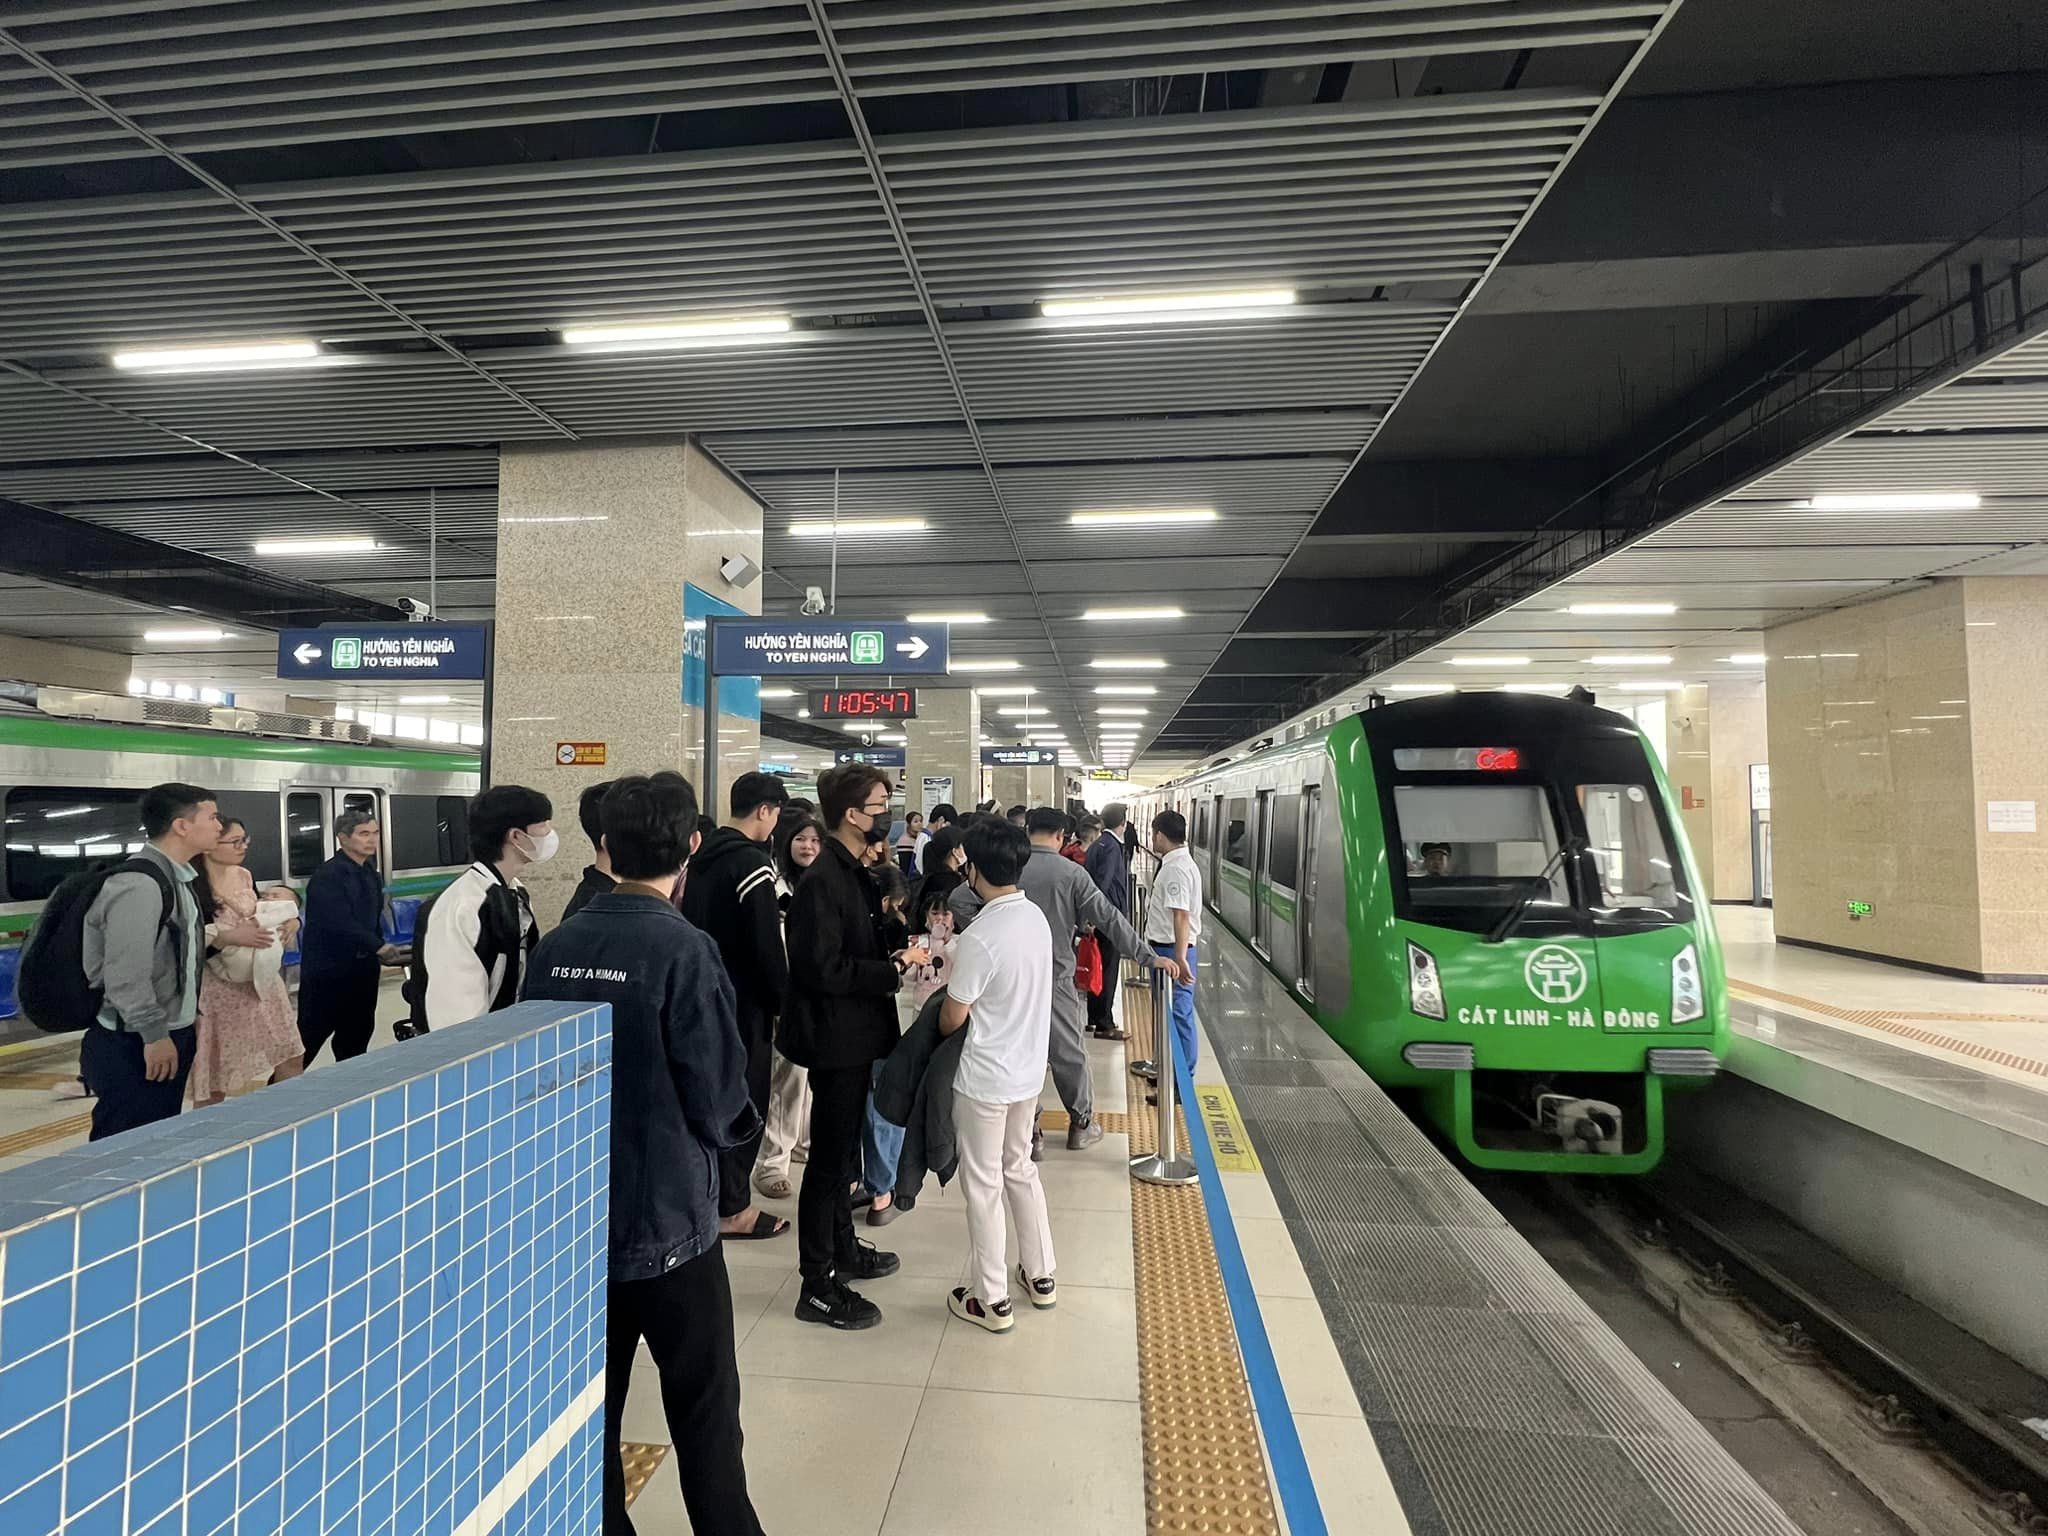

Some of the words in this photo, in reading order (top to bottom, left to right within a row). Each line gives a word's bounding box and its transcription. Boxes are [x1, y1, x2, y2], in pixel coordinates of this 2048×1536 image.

[363, 637, 400, 653] HƯỚNG
[402, 637, 421, 653] YÊN
[423, 637, 455, 653] NGHĨA
[745, 633, 786, 649] HƯỚNG
[788, 632, 810, 649] YÊN
[813, 633, 848, 649] NGHĨA
[362, 657, 378, 667] TO
[379, 657, 401, 667] YEN
[403, 657, 439, 667] NGHIA
[766, 652, 782, 662] TO
[784, 652, 809, 662] YEN
[810, 652, 848, 662] NGHIA
[823, 692, 909, 714] 11:05:47
[551, 967, 560, 977] IT
[560, 967, 570, 978] IS
[585, 968, 594, 979] A
[1504, 1008, 1549, 1026] LINH
[1568, 1007, 1595, 1027] HÀ
